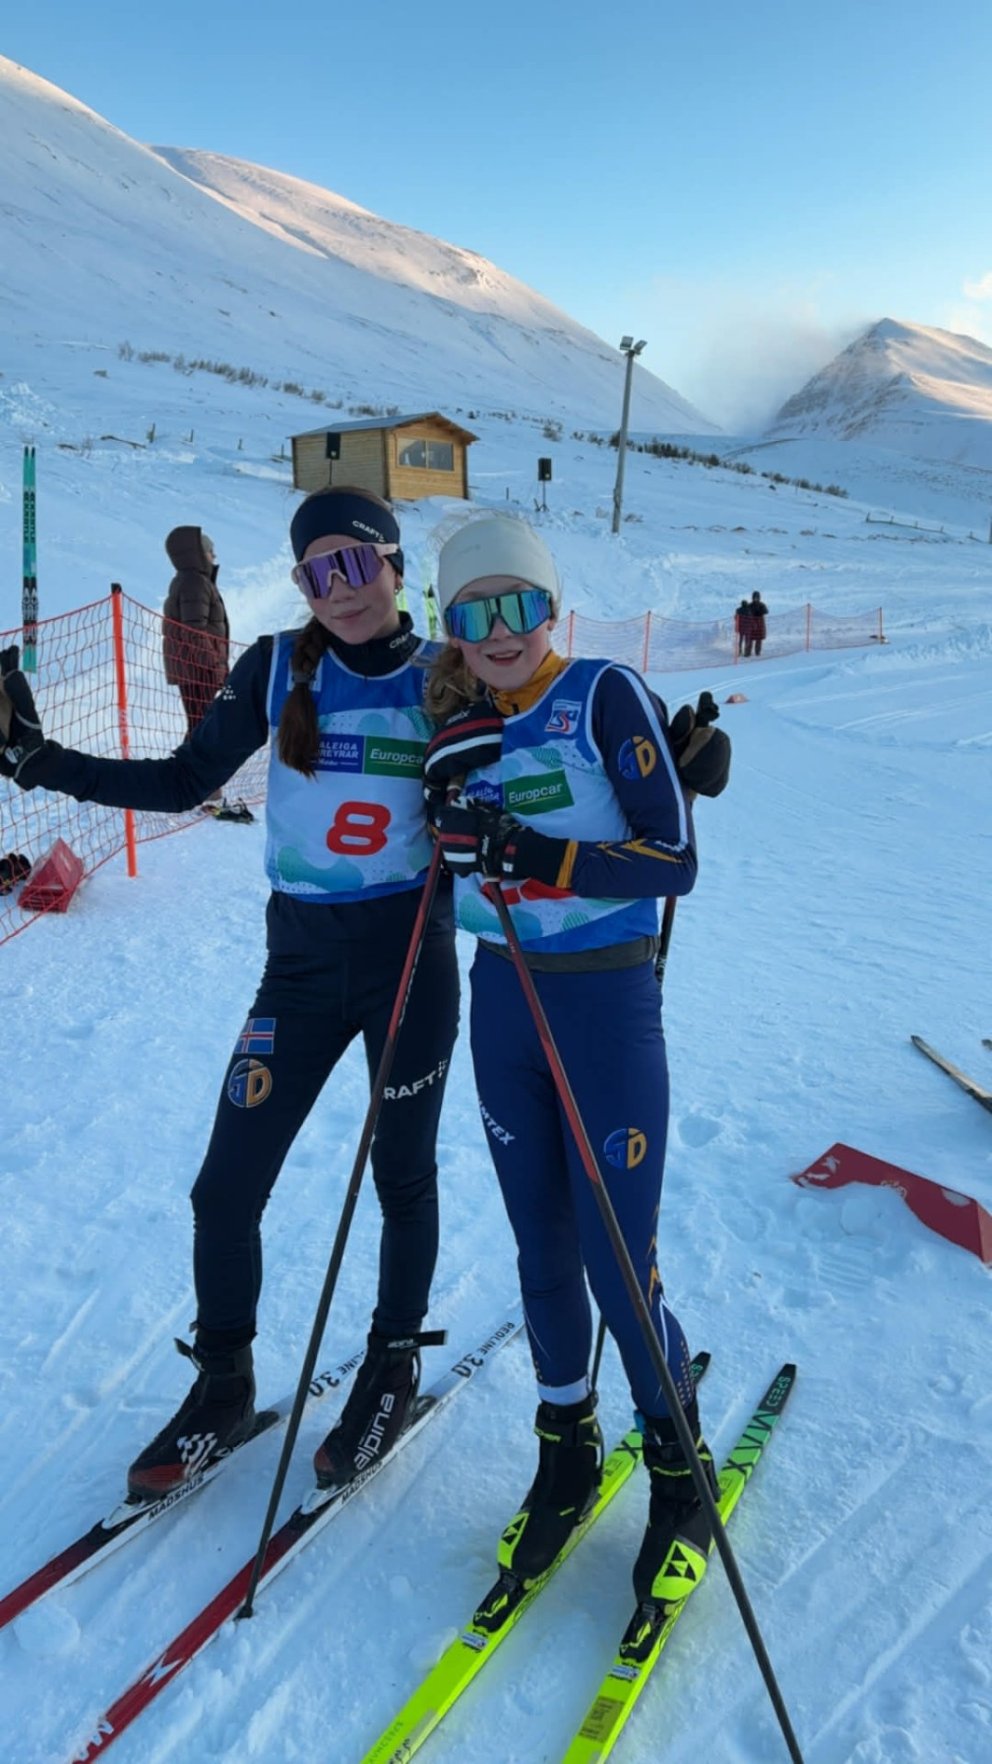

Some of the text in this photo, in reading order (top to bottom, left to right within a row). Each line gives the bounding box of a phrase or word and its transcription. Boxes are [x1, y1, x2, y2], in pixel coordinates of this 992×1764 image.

[352, 520, 380, 539] CRAFT
[508, 783, 563, 804] Europcar
[326, 801, 391, 856] 8
[384, 1071, 437, 1100] RAFT
[354, 1393, 395, 1470] alpina
[721, 1411, 780, 1476] MAX
[148, 1474, 204, 1521] MADSHUS
